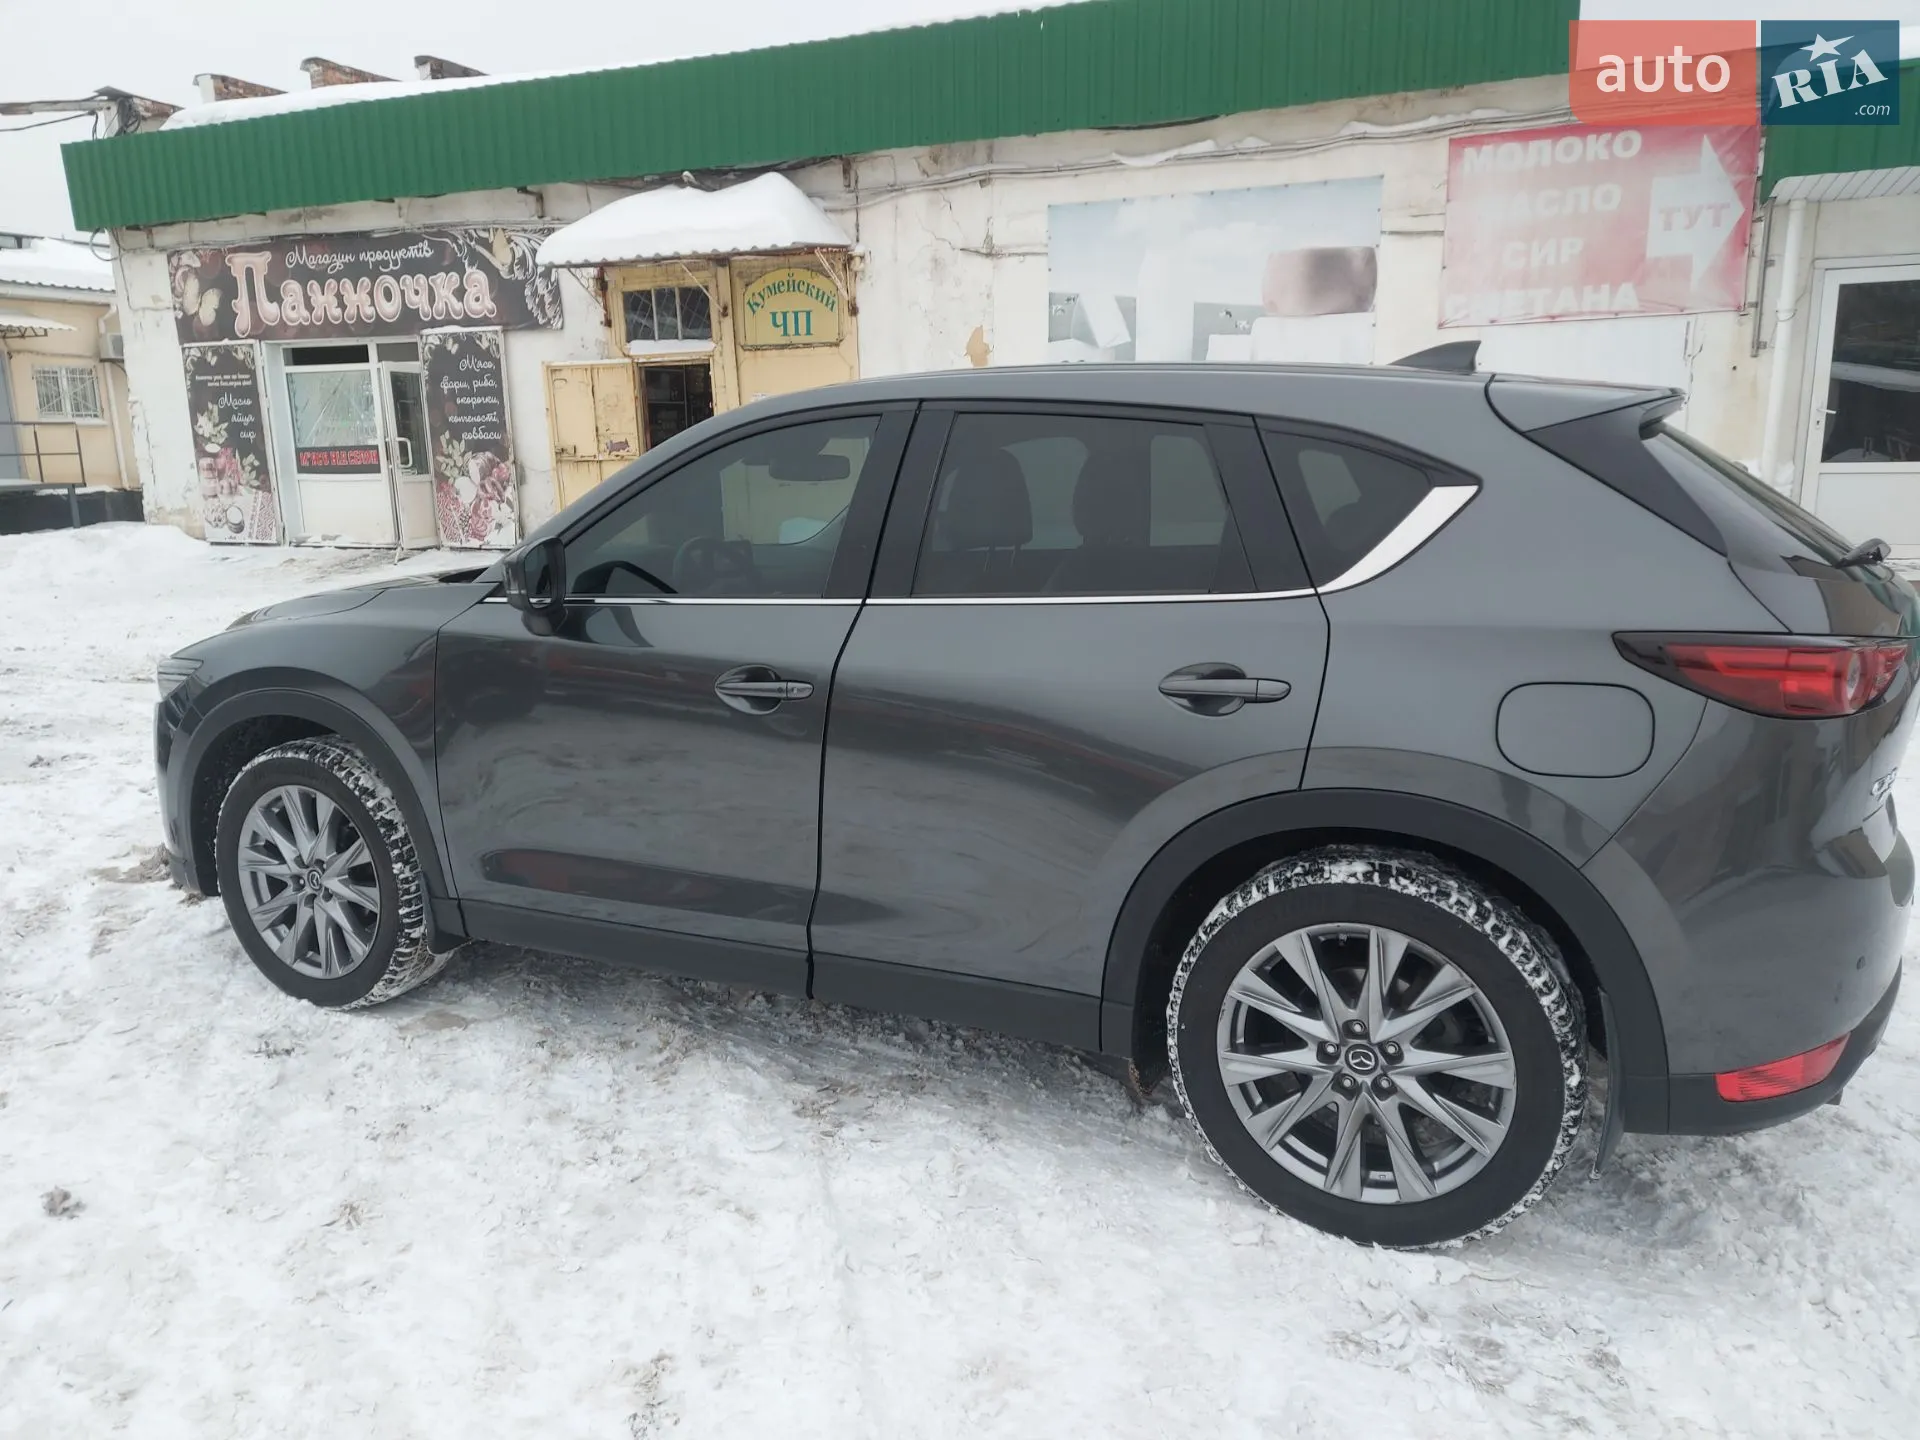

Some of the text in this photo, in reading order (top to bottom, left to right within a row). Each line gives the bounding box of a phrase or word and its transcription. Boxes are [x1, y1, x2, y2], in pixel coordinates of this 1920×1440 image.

[1462, 130, 1643, 173] МОЛОКО
[1478, 183, 1622, 224] АСЛО
[1659, 203, 1731, 231] ТУТ
[285, 239, 434, 274] Магазин продуктів
[1501, 237, 1585, 270] СИР
[225, 251, 497, 338] Панночка
[746, 272, 837, 315] Кумейский
[769, 309, 814, 337] ЧП
[459, 354, 496, 372] М'ясо,
[472, 373, 498, 393] риба,
[218, 391, 253, 410] Масло
[239, 430, 257, 444] сир
[461, 425, 502, 440] ковбаси
